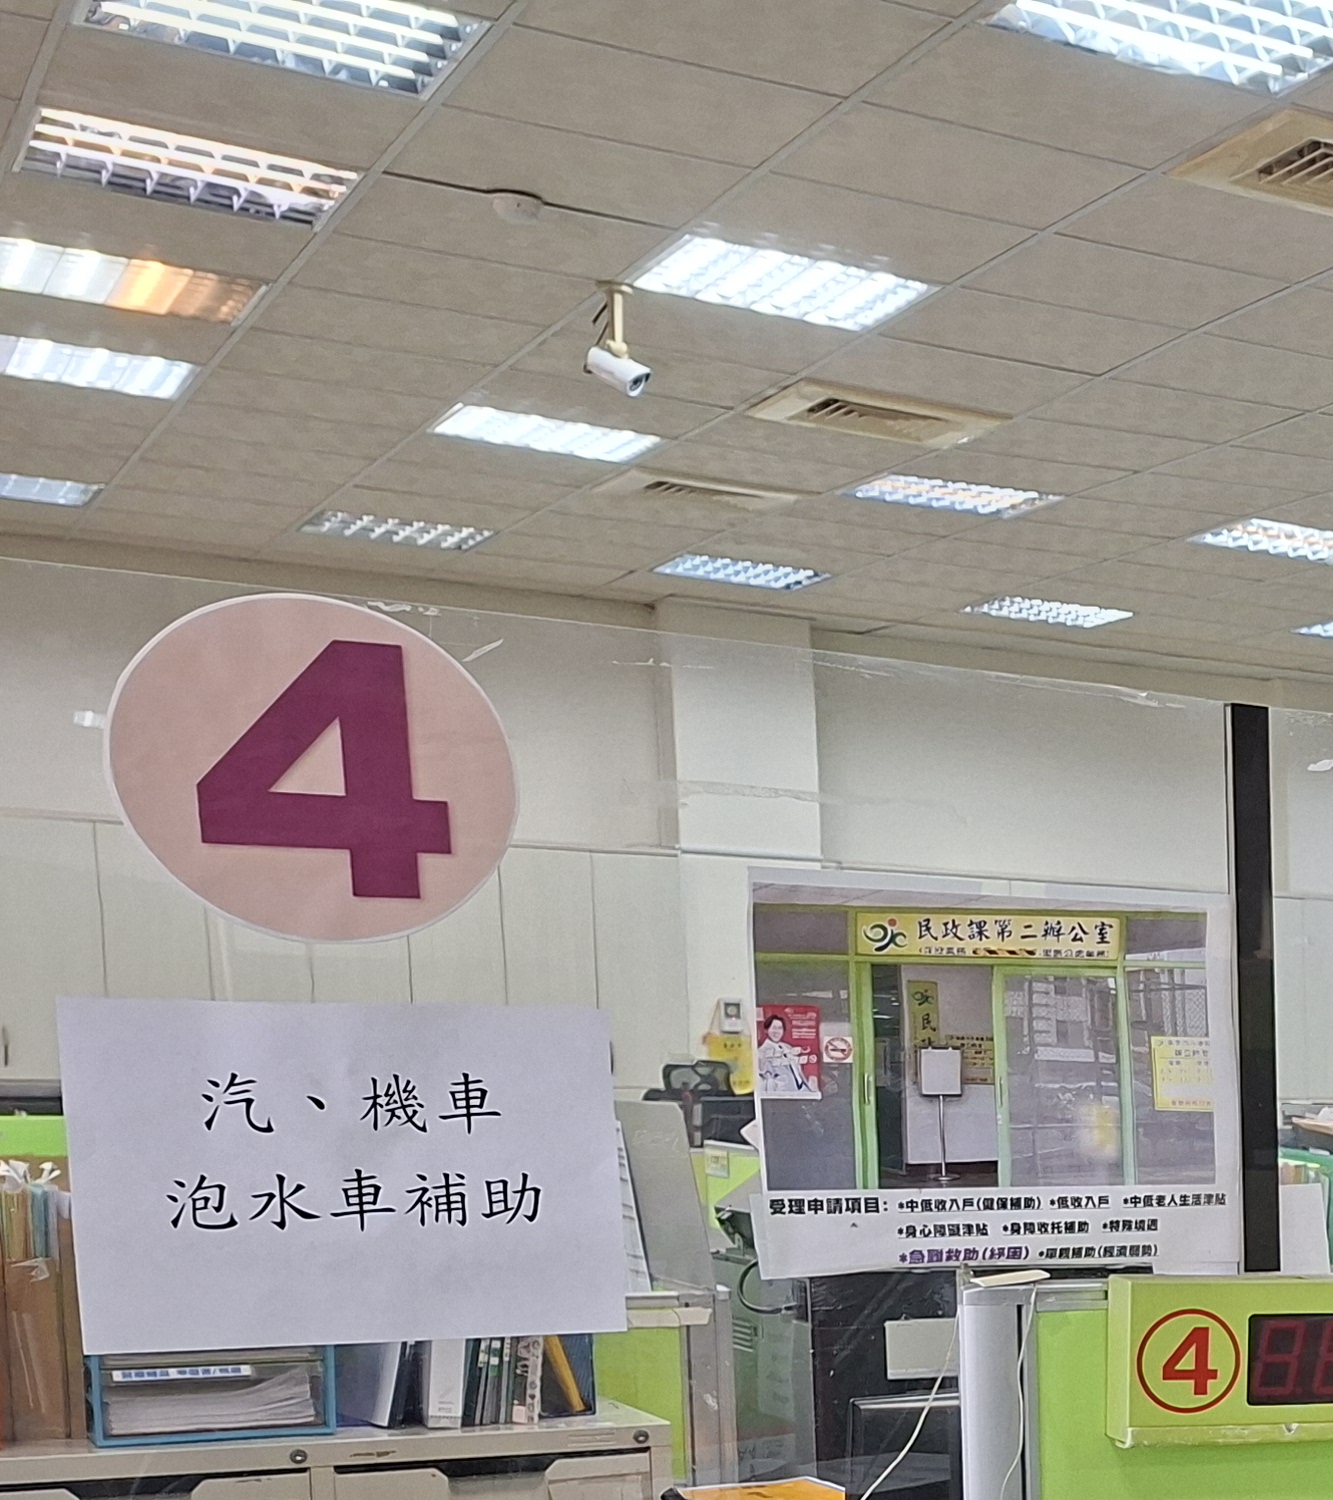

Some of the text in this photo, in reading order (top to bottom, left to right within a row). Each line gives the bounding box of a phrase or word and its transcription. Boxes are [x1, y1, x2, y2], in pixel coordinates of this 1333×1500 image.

[196, 639, 452, 900] 4
[917, 918, 1113, 945] 民政課第二辦公室
[200, 1071, 503, 1135] 汽、機車
[165, 1168, 543, 1232] 泡水車補助
[1162, 1327, 1218, 1395] 4
